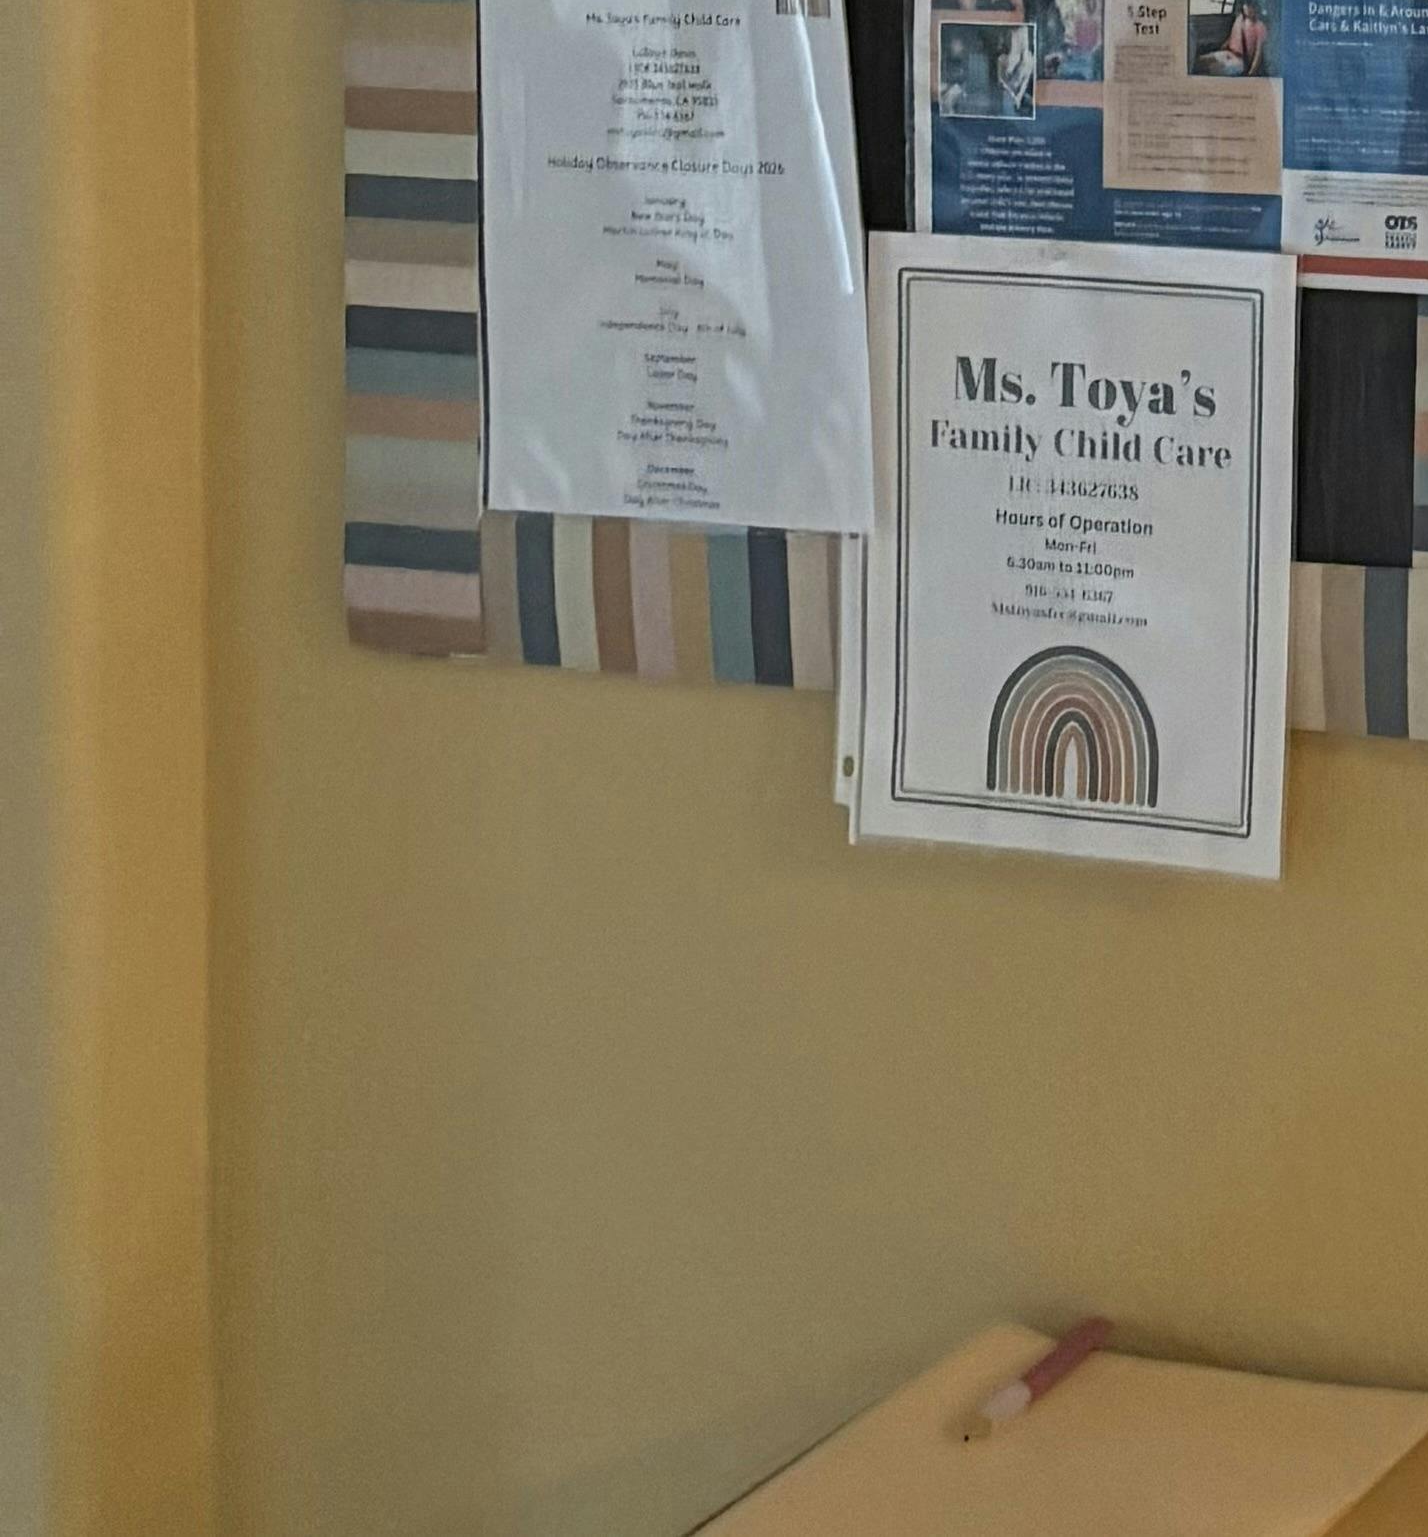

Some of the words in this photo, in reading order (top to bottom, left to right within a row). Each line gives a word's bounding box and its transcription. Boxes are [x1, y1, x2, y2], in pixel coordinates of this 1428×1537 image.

[1138, 6, 1166, 20] Step
[1309, 2, 1361, 18] Dangers
[1363, 4, 1376, 16] In
[1134, 22, 1159, 35] Test
[1309, 19, 1336, 32] Cars
[1353, 20, 1409, 35] Kaitlyn's
[955, 356, 1035, 405] Ms.
[1051, 362, 1215, 427] Toya's
[931, 420, 1042, 462] Family
[1055, 428, 1141, 462] Child
[1154, 436, 1231, 469] Care
[996, 509, 1043, 528] Hours
[1049, 514, 1065, 528] of
[1070, 516, 1153, 535] Operation
[1045, 538, 1096, 554] Mon-Fri
